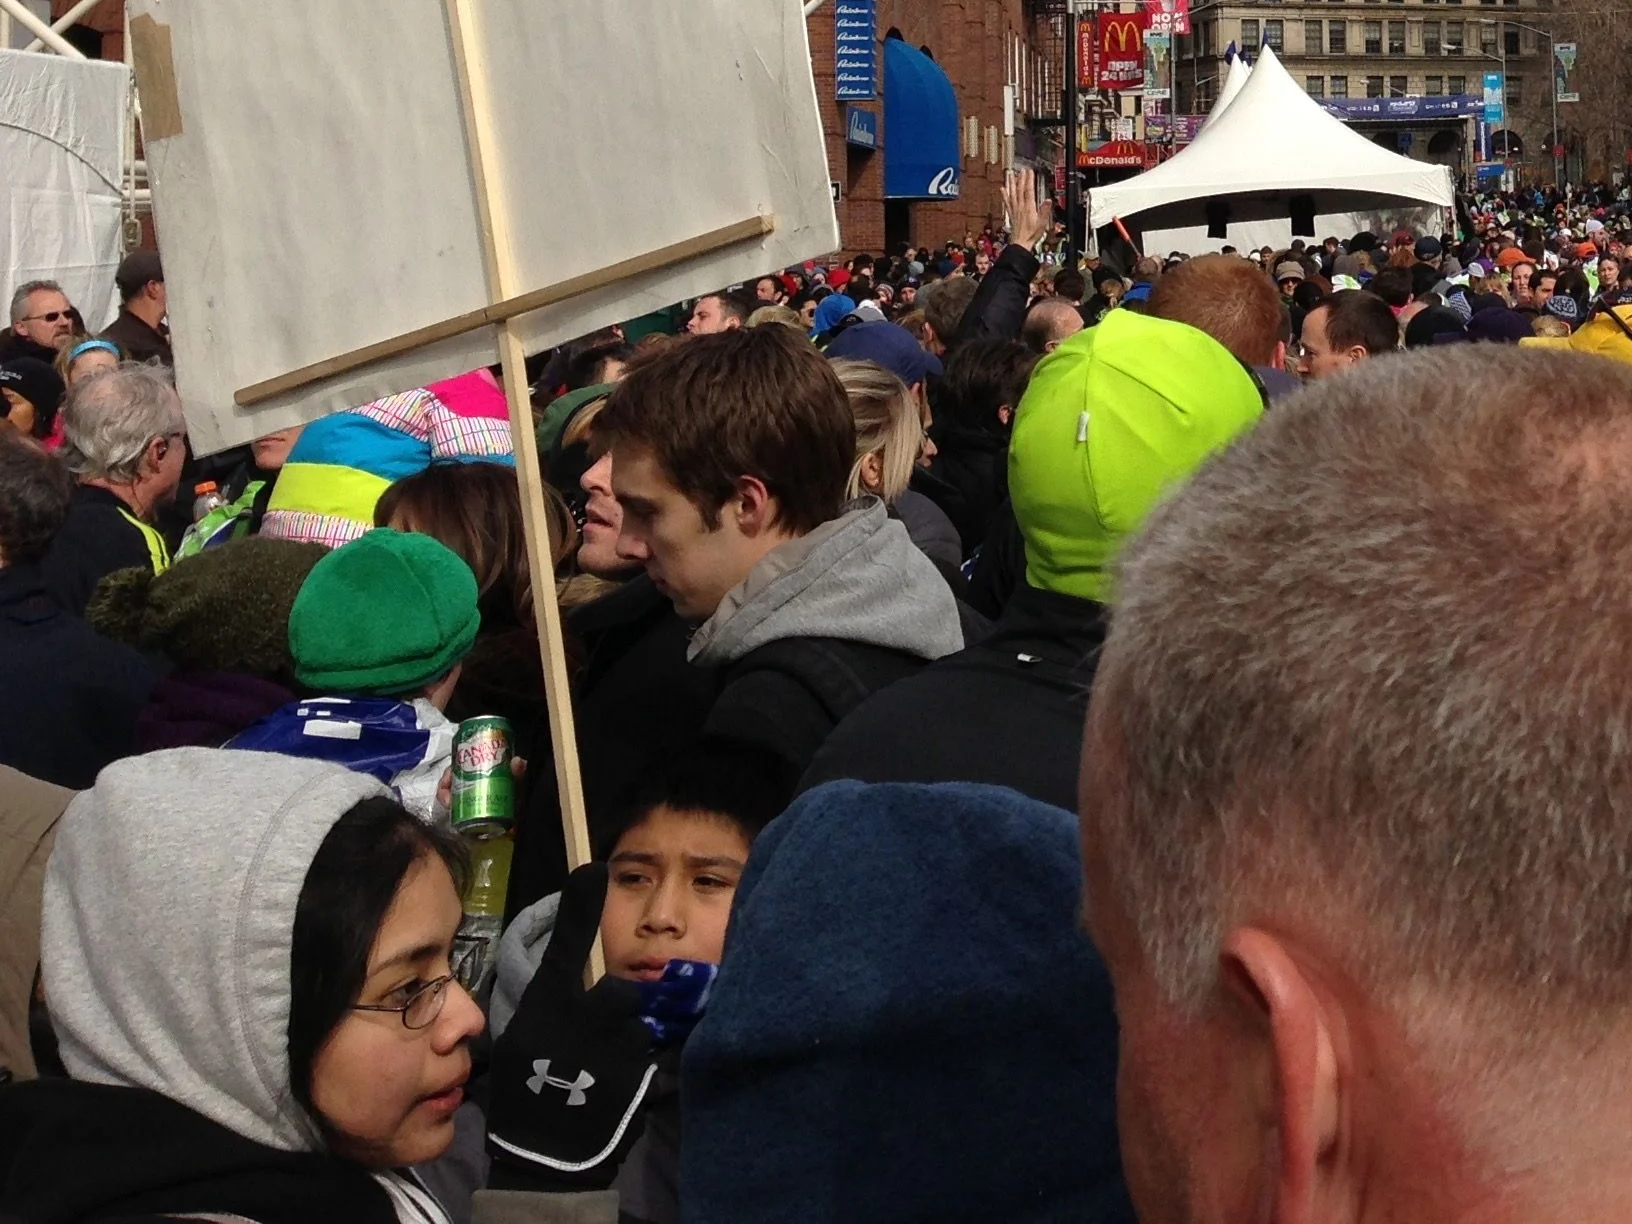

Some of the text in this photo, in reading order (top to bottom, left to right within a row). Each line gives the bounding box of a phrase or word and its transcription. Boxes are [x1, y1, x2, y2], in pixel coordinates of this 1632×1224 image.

[1107, 60, 1138, 71] OPEN
[1101, 70, 1118, 81] 24
[1078, 154, 1142, 165] McDonald's
[471, 751, 498, 766] DRY
